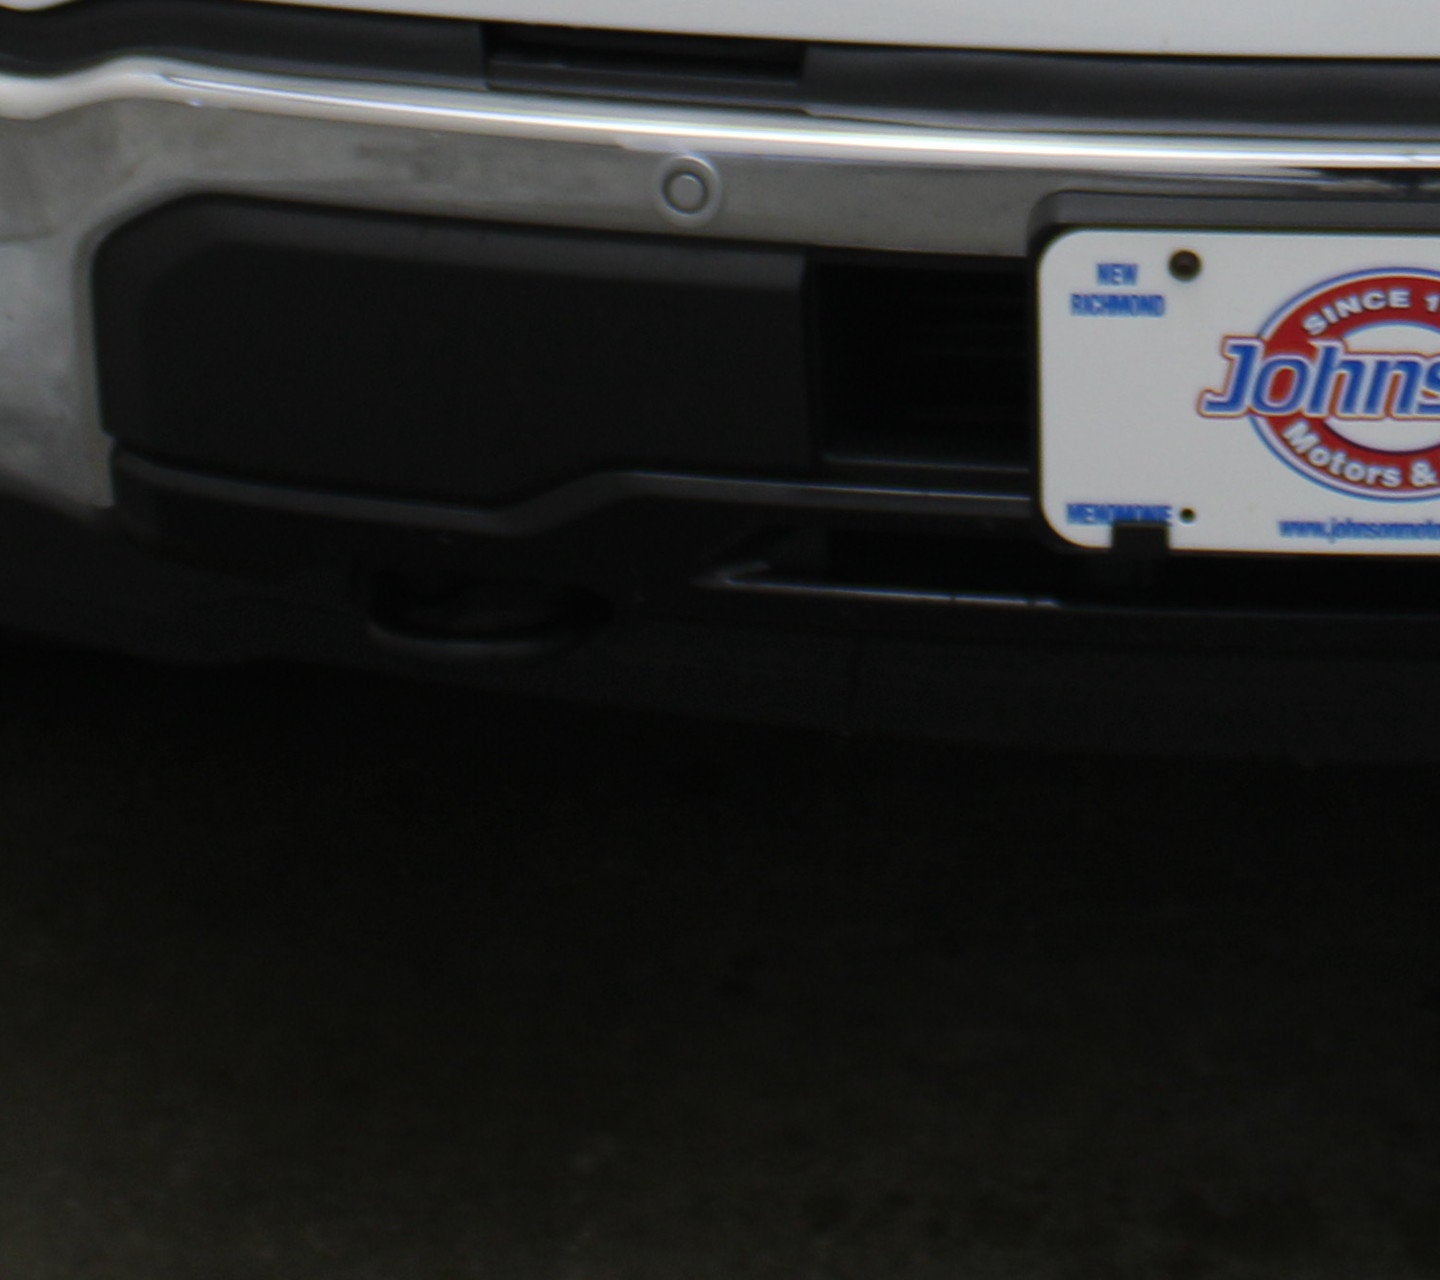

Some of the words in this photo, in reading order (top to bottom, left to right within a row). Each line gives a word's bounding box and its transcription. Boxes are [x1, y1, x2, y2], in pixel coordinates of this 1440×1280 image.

[1096, 263, 1138, 286] NEW
[1071, 293, 1165, 317] RICHMOND
[1302, 289, 1412, 337] SINCE
[1282, 421, 1401, 488] Motors
[1410, 460, 1438, 487] &
